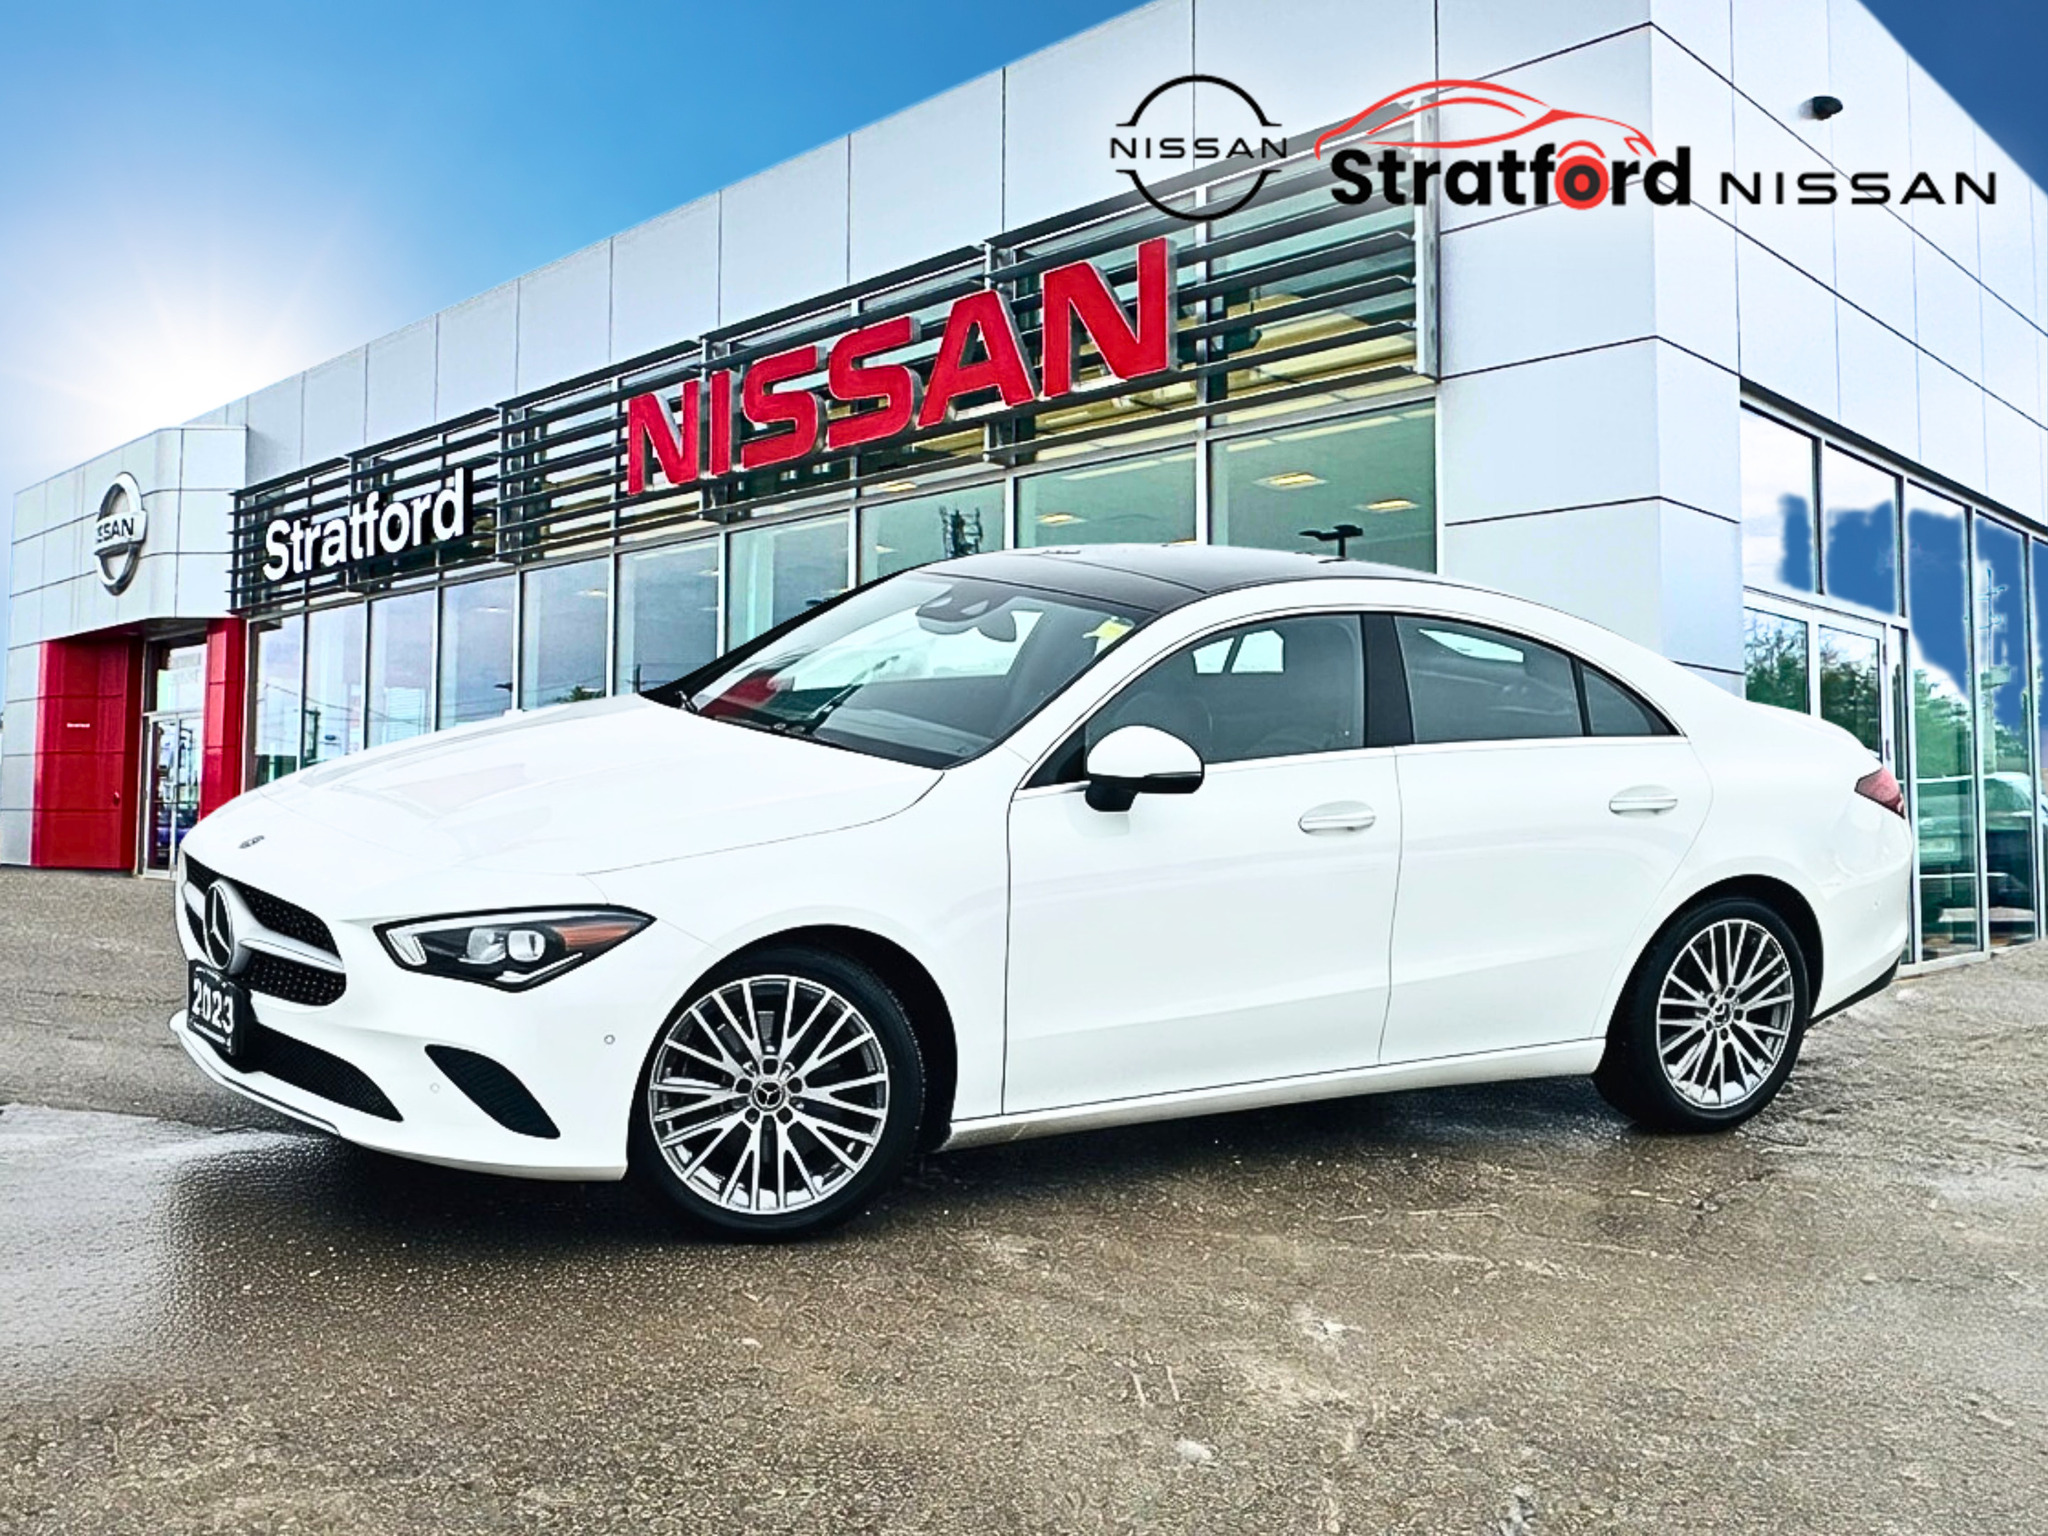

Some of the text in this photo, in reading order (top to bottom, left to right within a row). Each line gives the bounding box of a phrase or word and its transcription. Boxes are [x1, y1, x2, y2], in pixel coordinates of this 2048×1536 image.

[626, 237, 1176, 496] NISSAN
[262, 467, 466, 581] Stratford
[191, 977, 234, 1034] 2023
